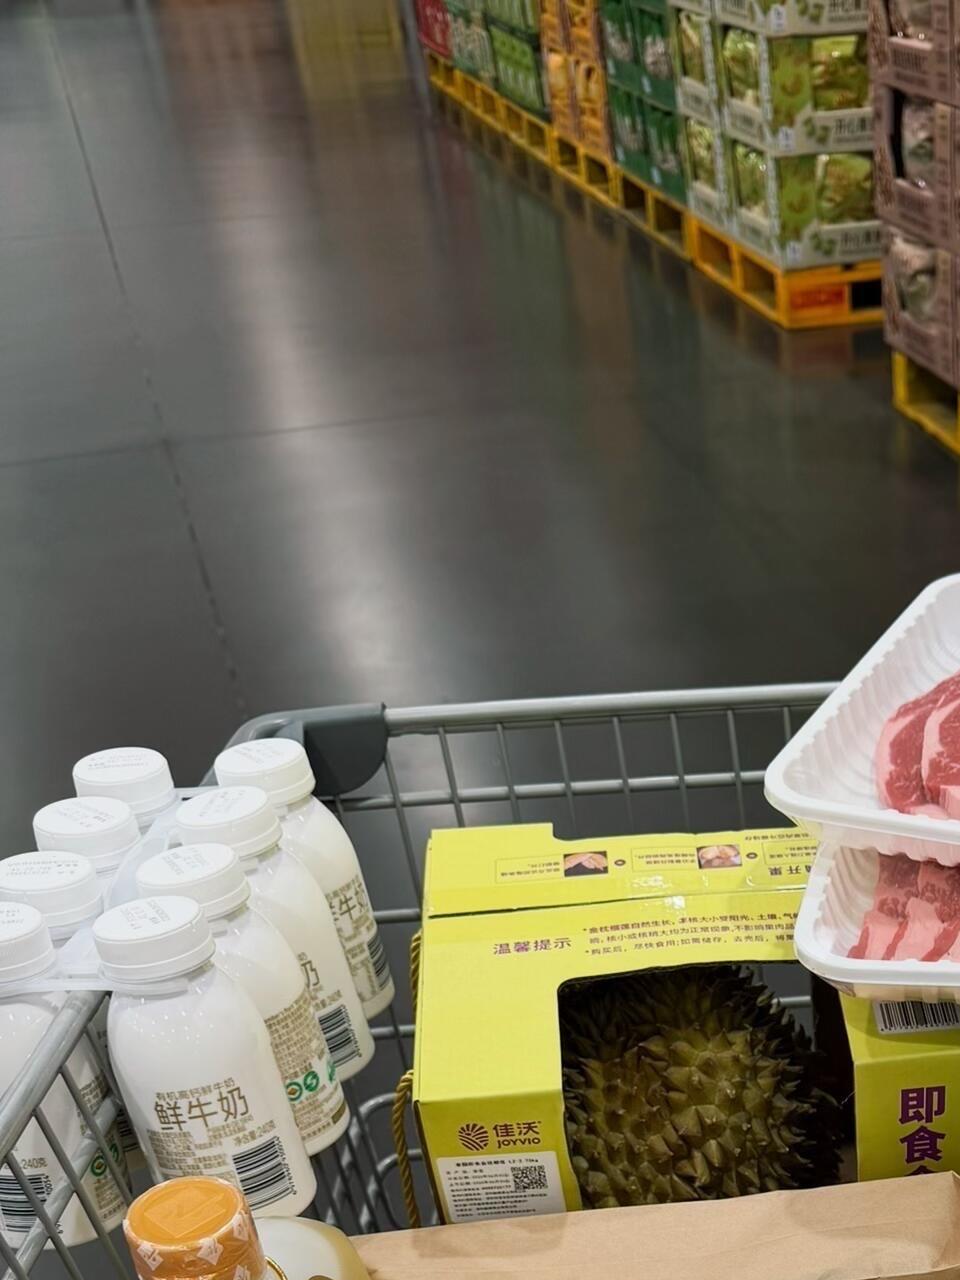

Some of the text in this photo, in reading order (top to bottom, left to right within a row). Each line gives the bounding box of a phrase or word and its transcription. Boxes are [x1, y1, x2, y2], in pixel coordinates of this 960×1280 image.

[492, 937, 573, 955] 温馨提示
[155, 1086, 249, 1132] 鲜牛奶
[493, 1121, 540, 1138] 佳沃
[497, 1137, 541, 1149] JOYVIO
